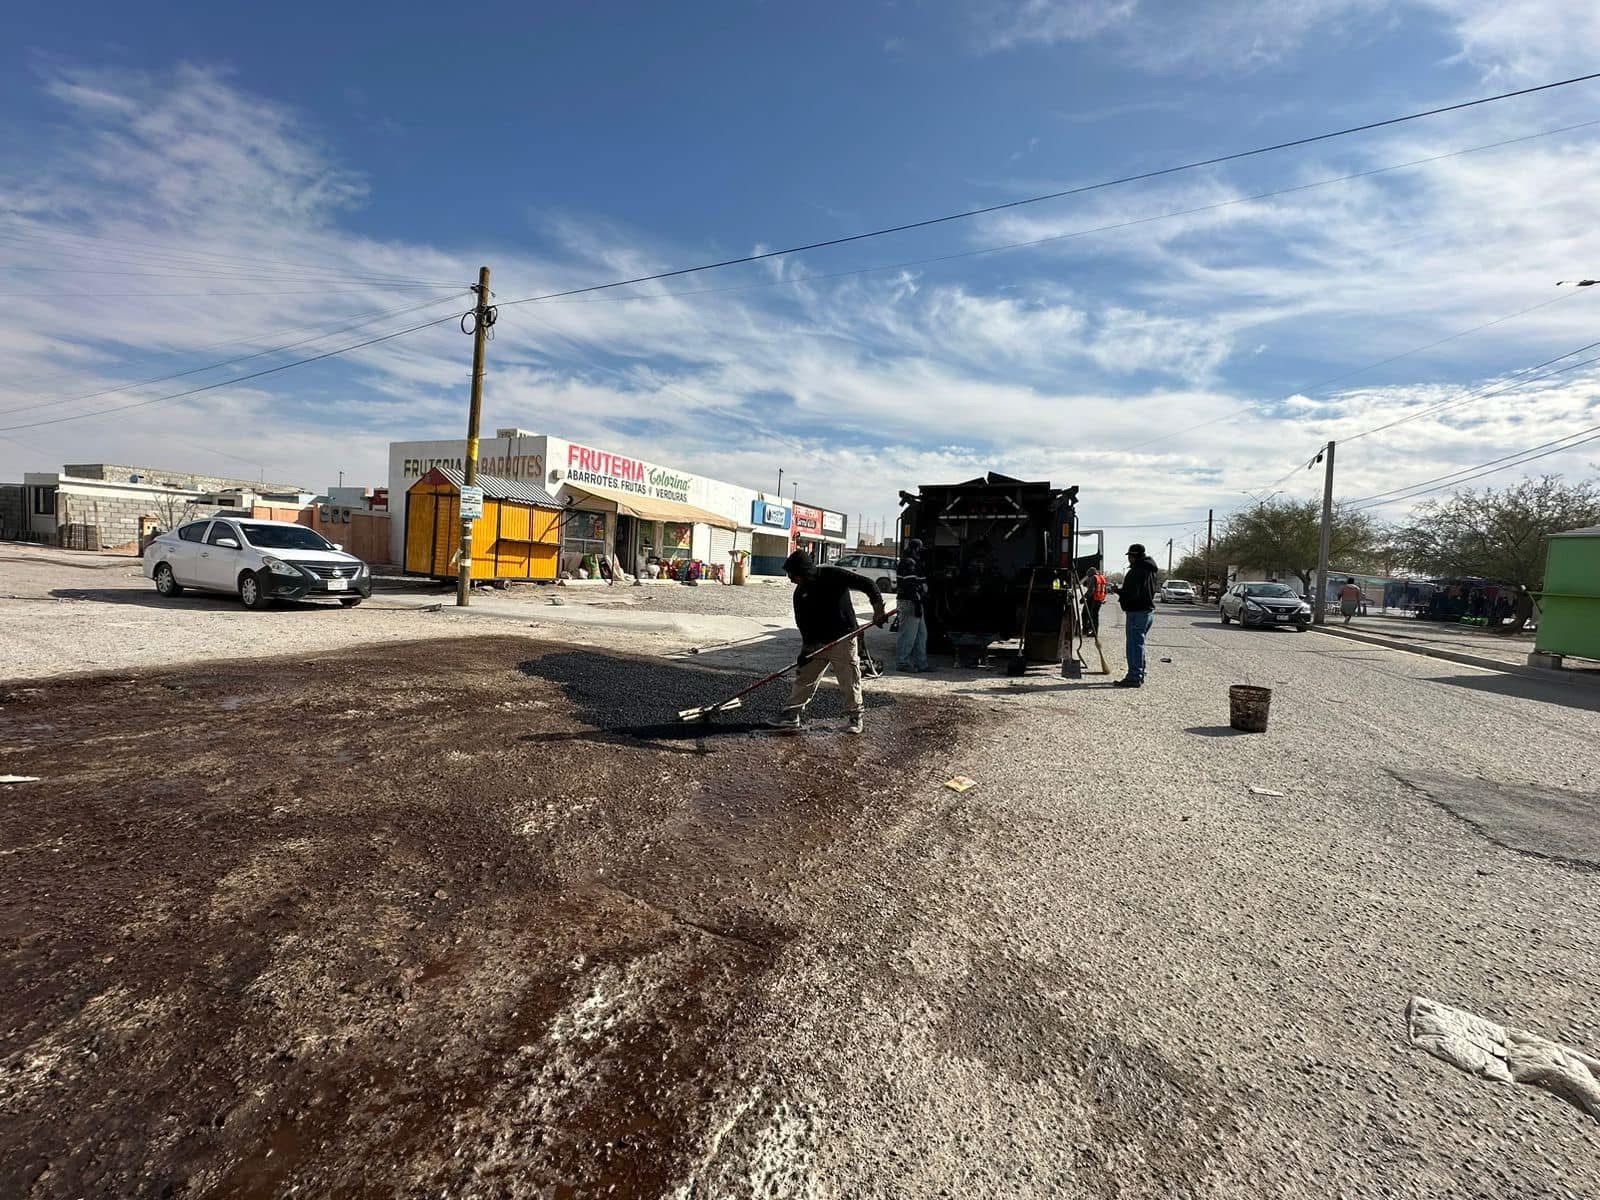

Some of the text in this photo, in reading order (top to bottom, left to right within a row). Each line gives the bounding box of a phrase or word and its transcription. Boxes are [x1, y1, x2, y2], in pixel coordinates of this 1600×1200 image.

[476, 455, 542, 478] BARROTES
[568, 444, 645, 483] FRUTERIA
[620, 480, 646, 495] FRUTAS
